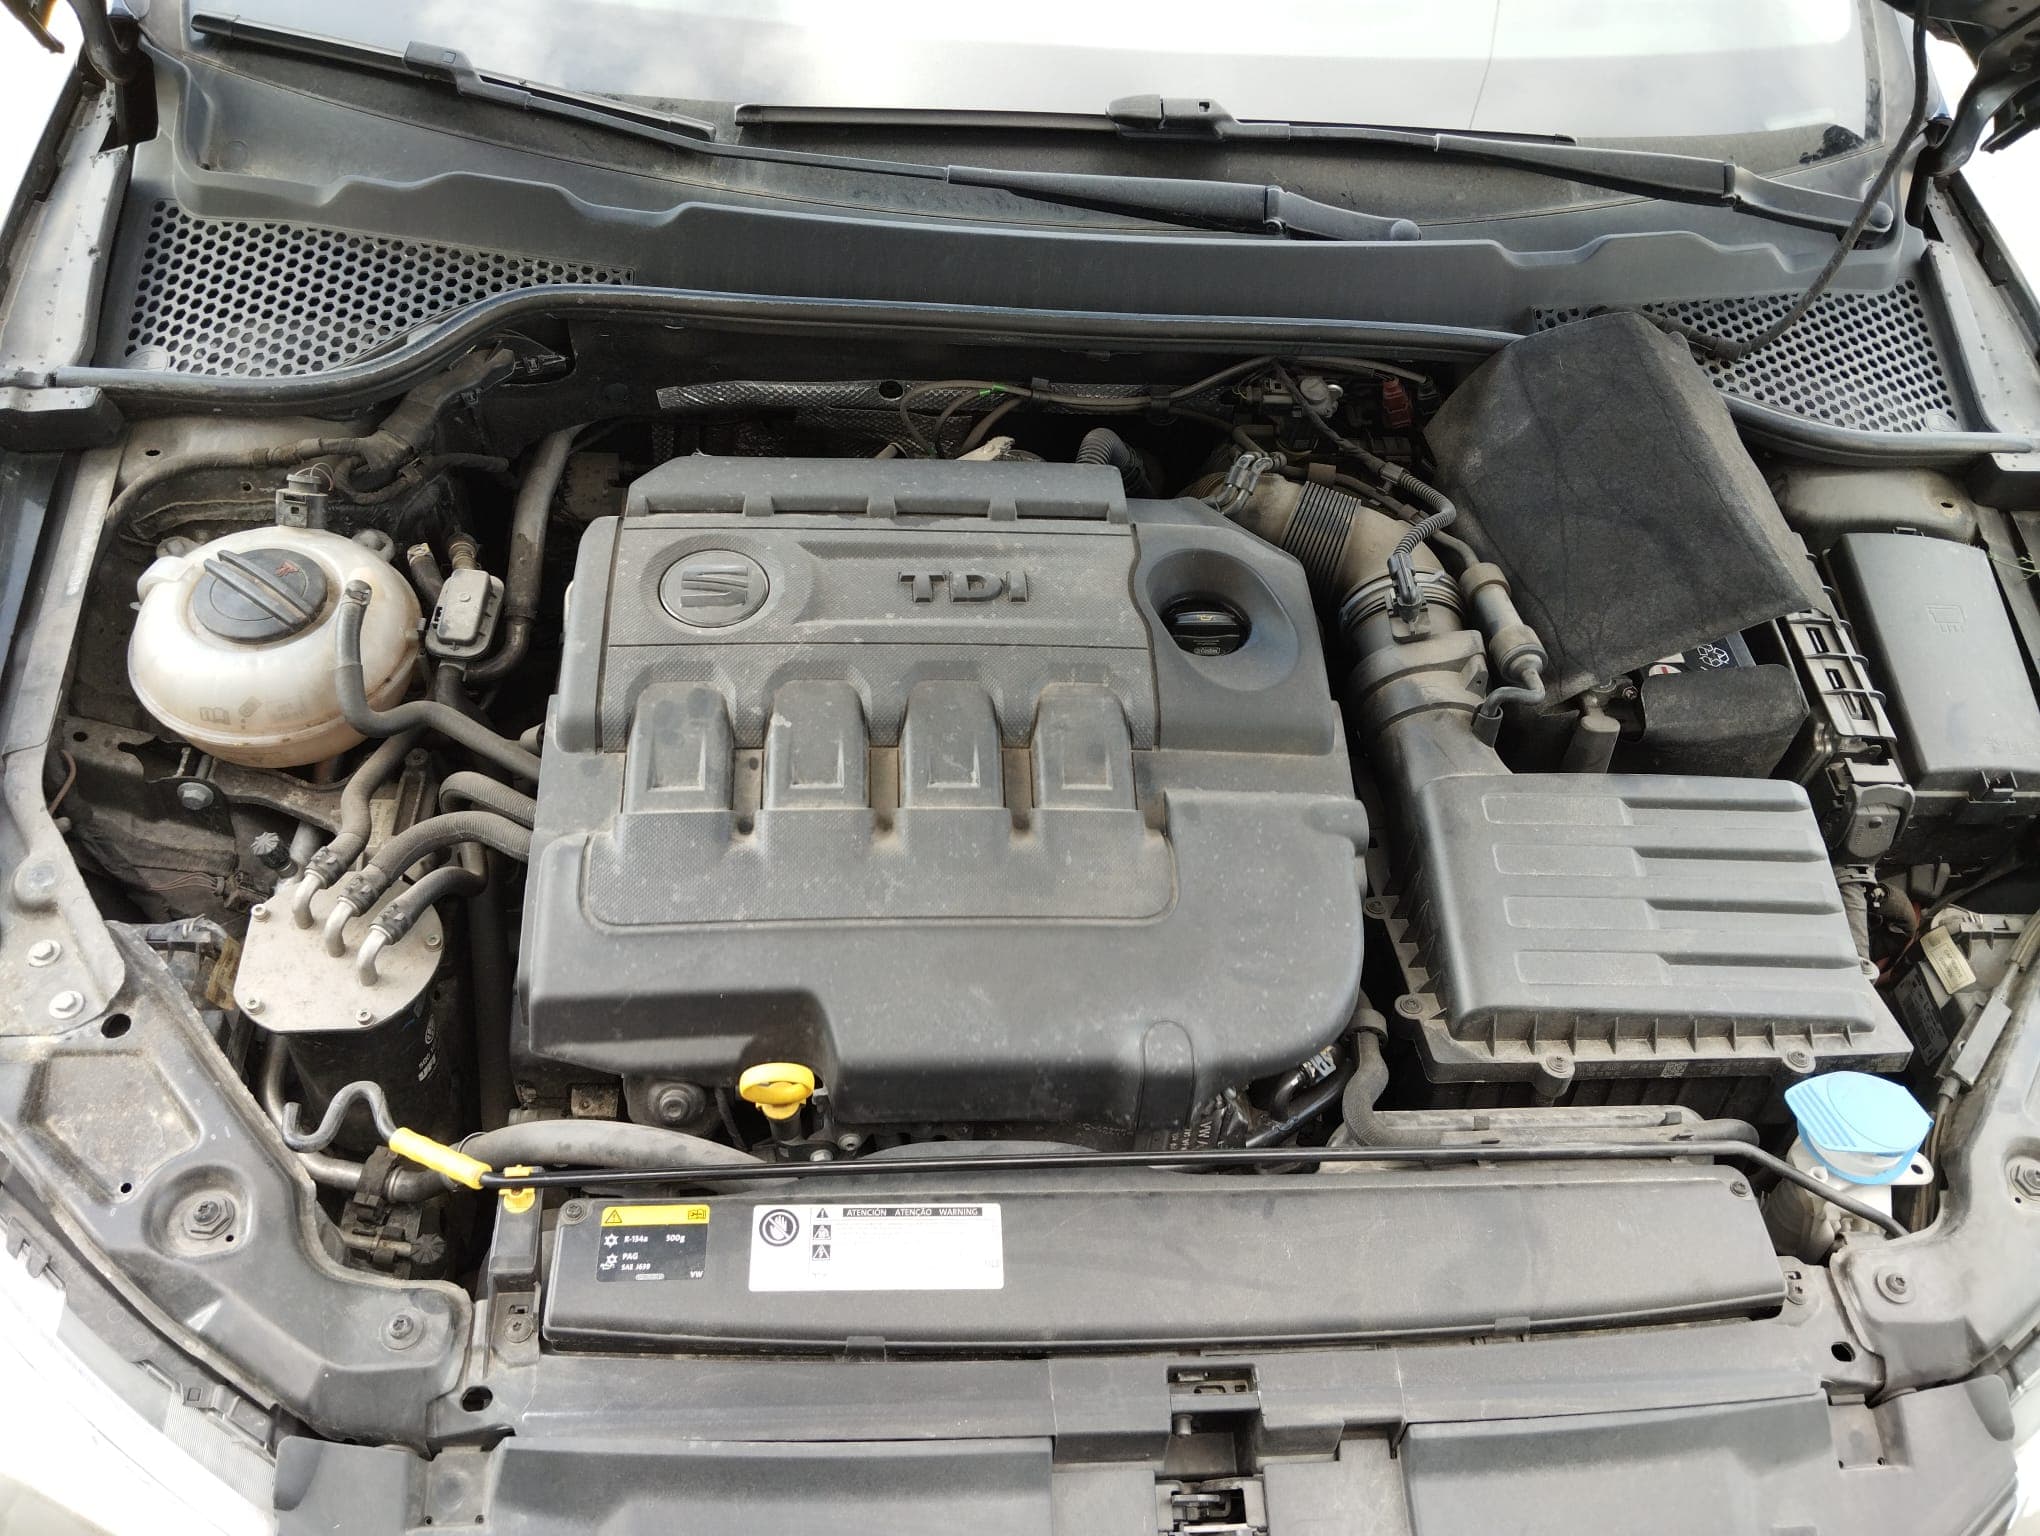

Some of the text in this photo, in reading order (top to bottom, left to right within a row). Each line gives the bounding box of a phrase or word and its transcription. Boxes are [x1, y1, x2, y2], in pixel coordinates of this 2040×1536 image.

[898, 570, 1029, 604] TDI
[846, 1207, 978, 1217] ATENCIÓN ATENÇÃO WARNING
[622, 1252, 639, 1261] PAG
[690, 1270, 703, 1278] VW
